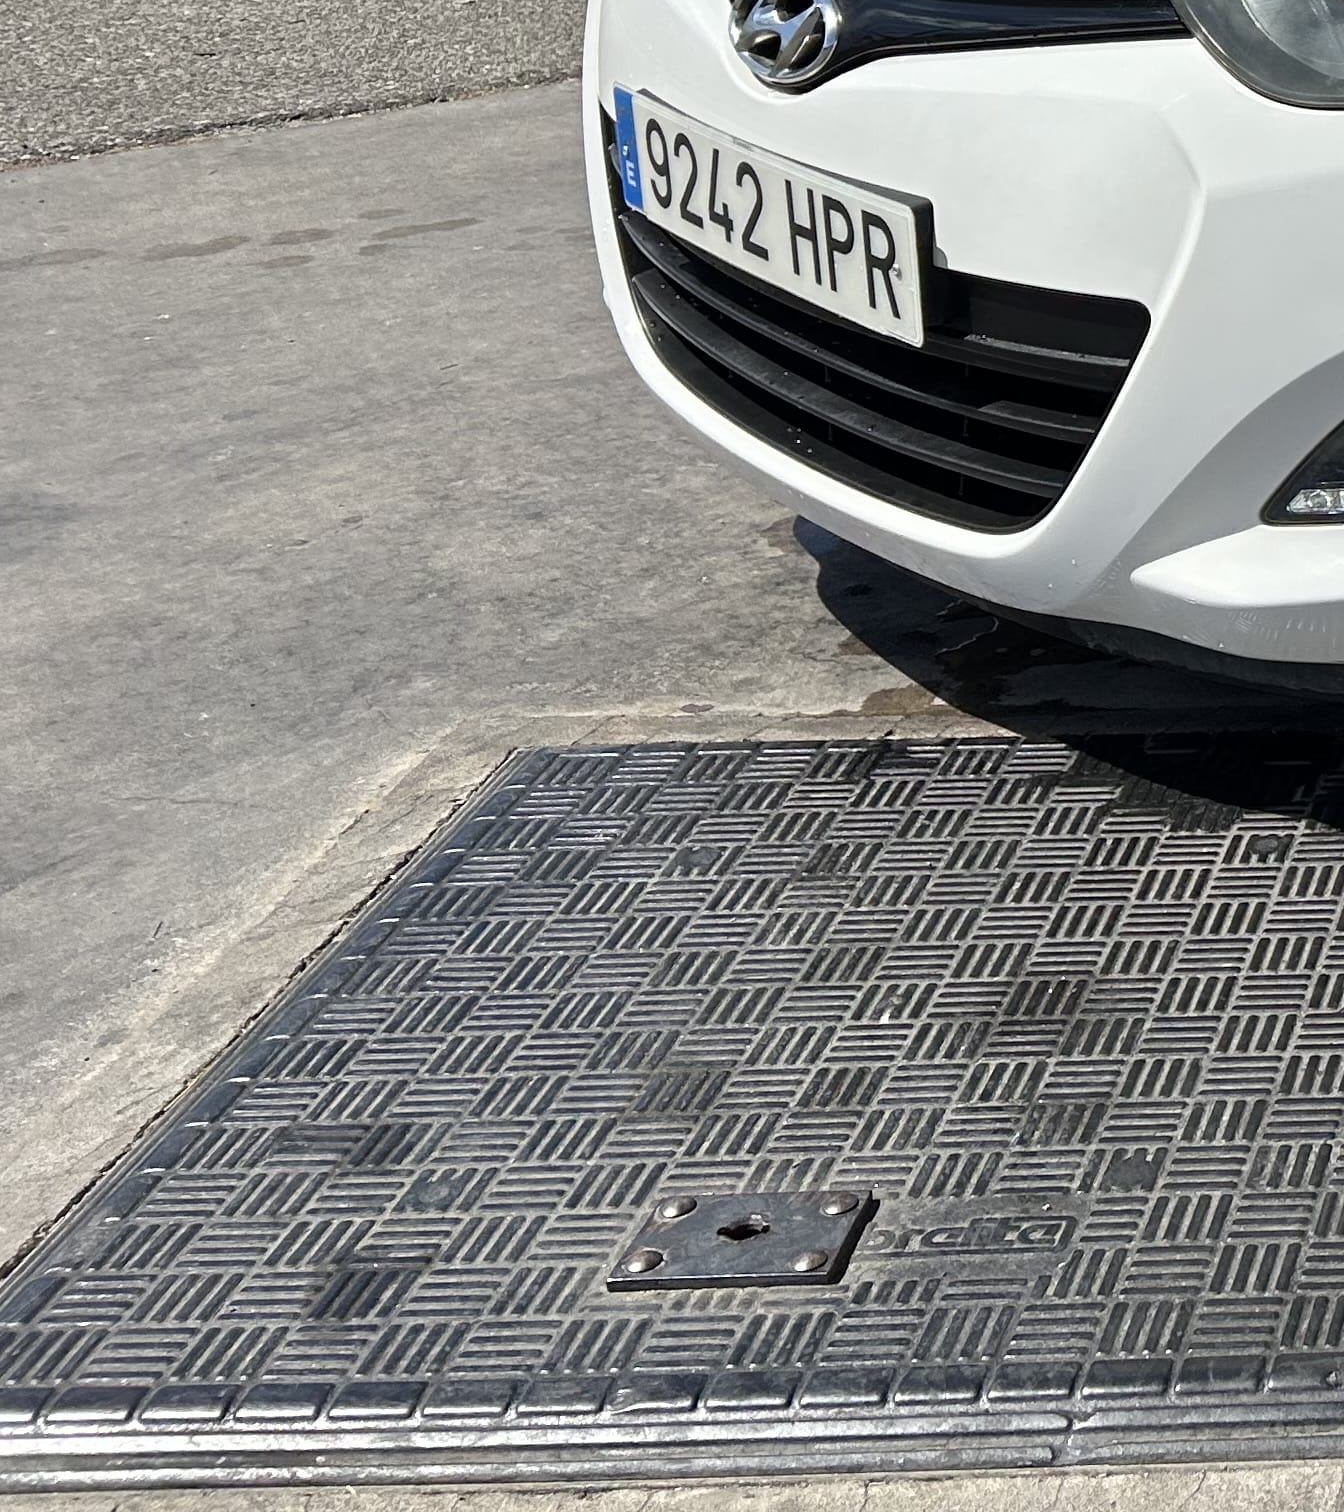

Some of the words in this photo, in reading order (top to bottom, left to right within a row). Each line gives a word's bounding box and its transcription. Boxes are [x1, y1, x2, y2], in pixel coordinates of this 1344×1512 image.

[624, 160, 637, 187] E
[646, 118, 769, 261] 9242
[784, 180, 901, 320] HPR
